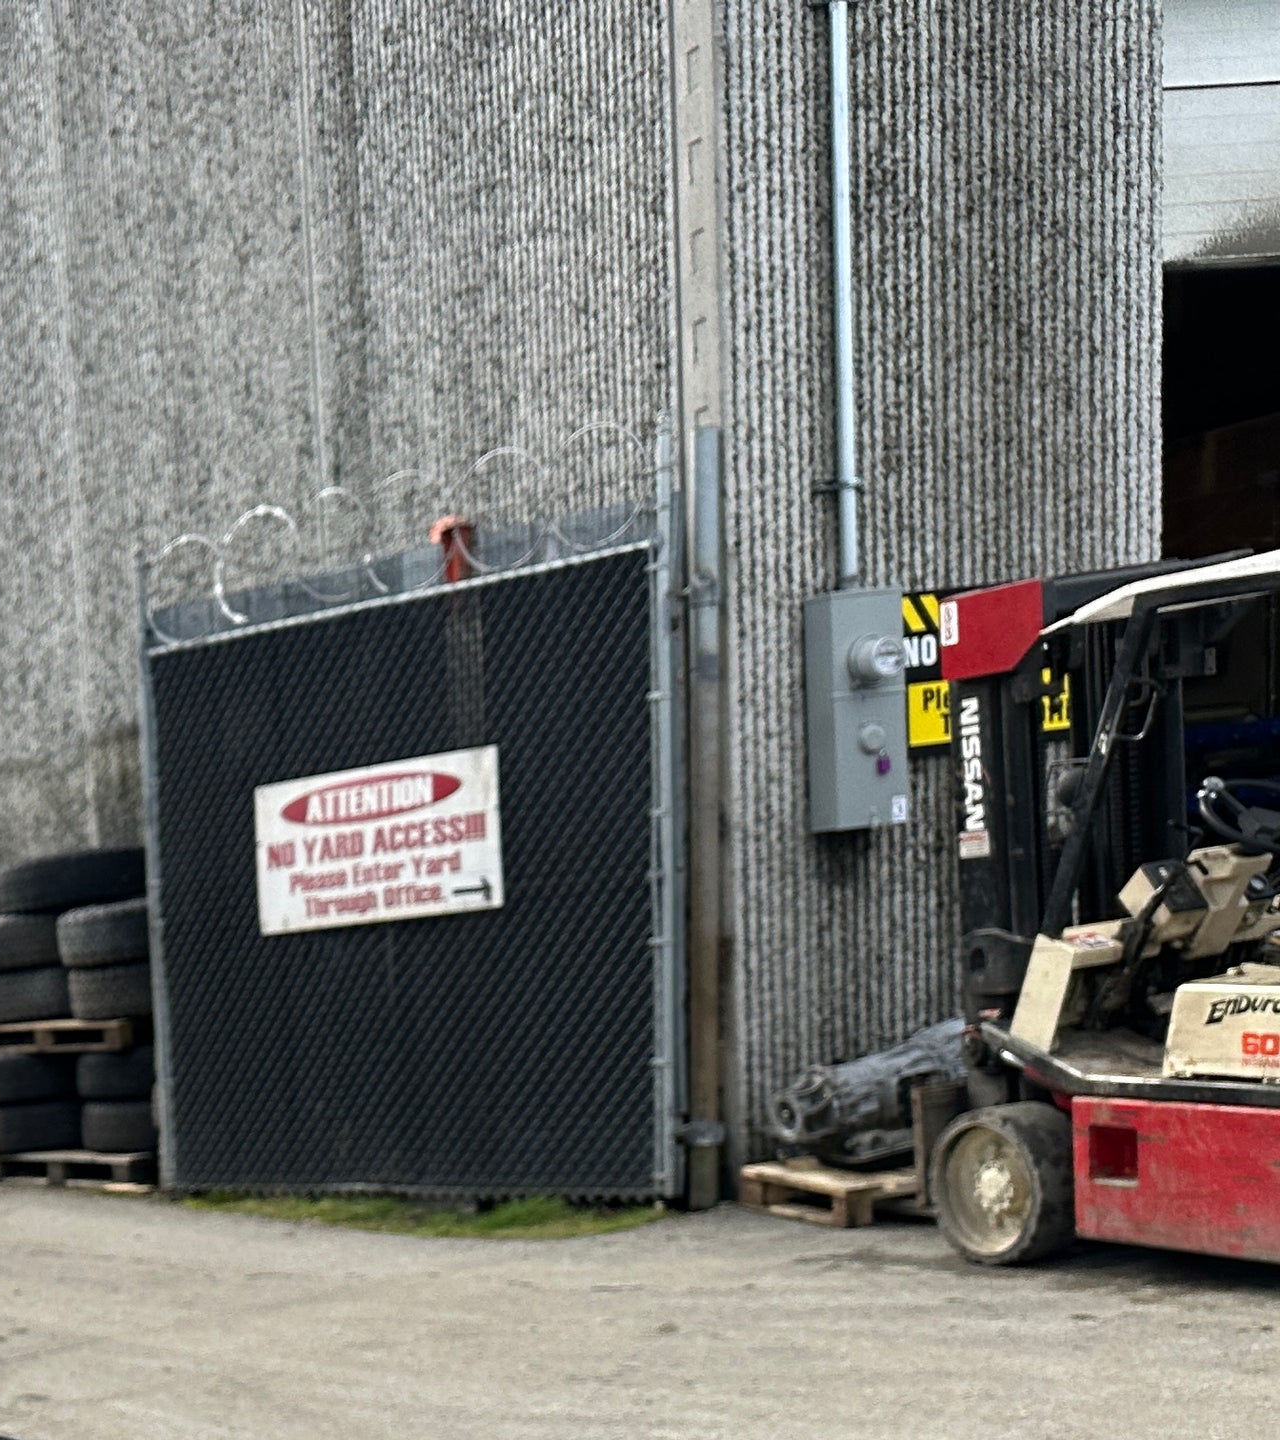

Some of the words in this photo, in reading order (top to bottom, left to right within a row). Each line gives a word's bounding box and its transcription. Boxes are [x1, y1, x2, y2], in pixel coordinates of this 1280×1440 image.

[904, 634, 938, 668] NO
[960, 697, 985, 831] NISSAN
[304, 773, 434, 824] ATTENTION
[267, 841, 296, 871] NO
[303, 832, 365, 865] YARD
[290, 869, 347, 894] Please
[352, 861, 406, 885] Enter
[411, 851, 462, 876] Yard
[305, 892, 378, 918] Through
